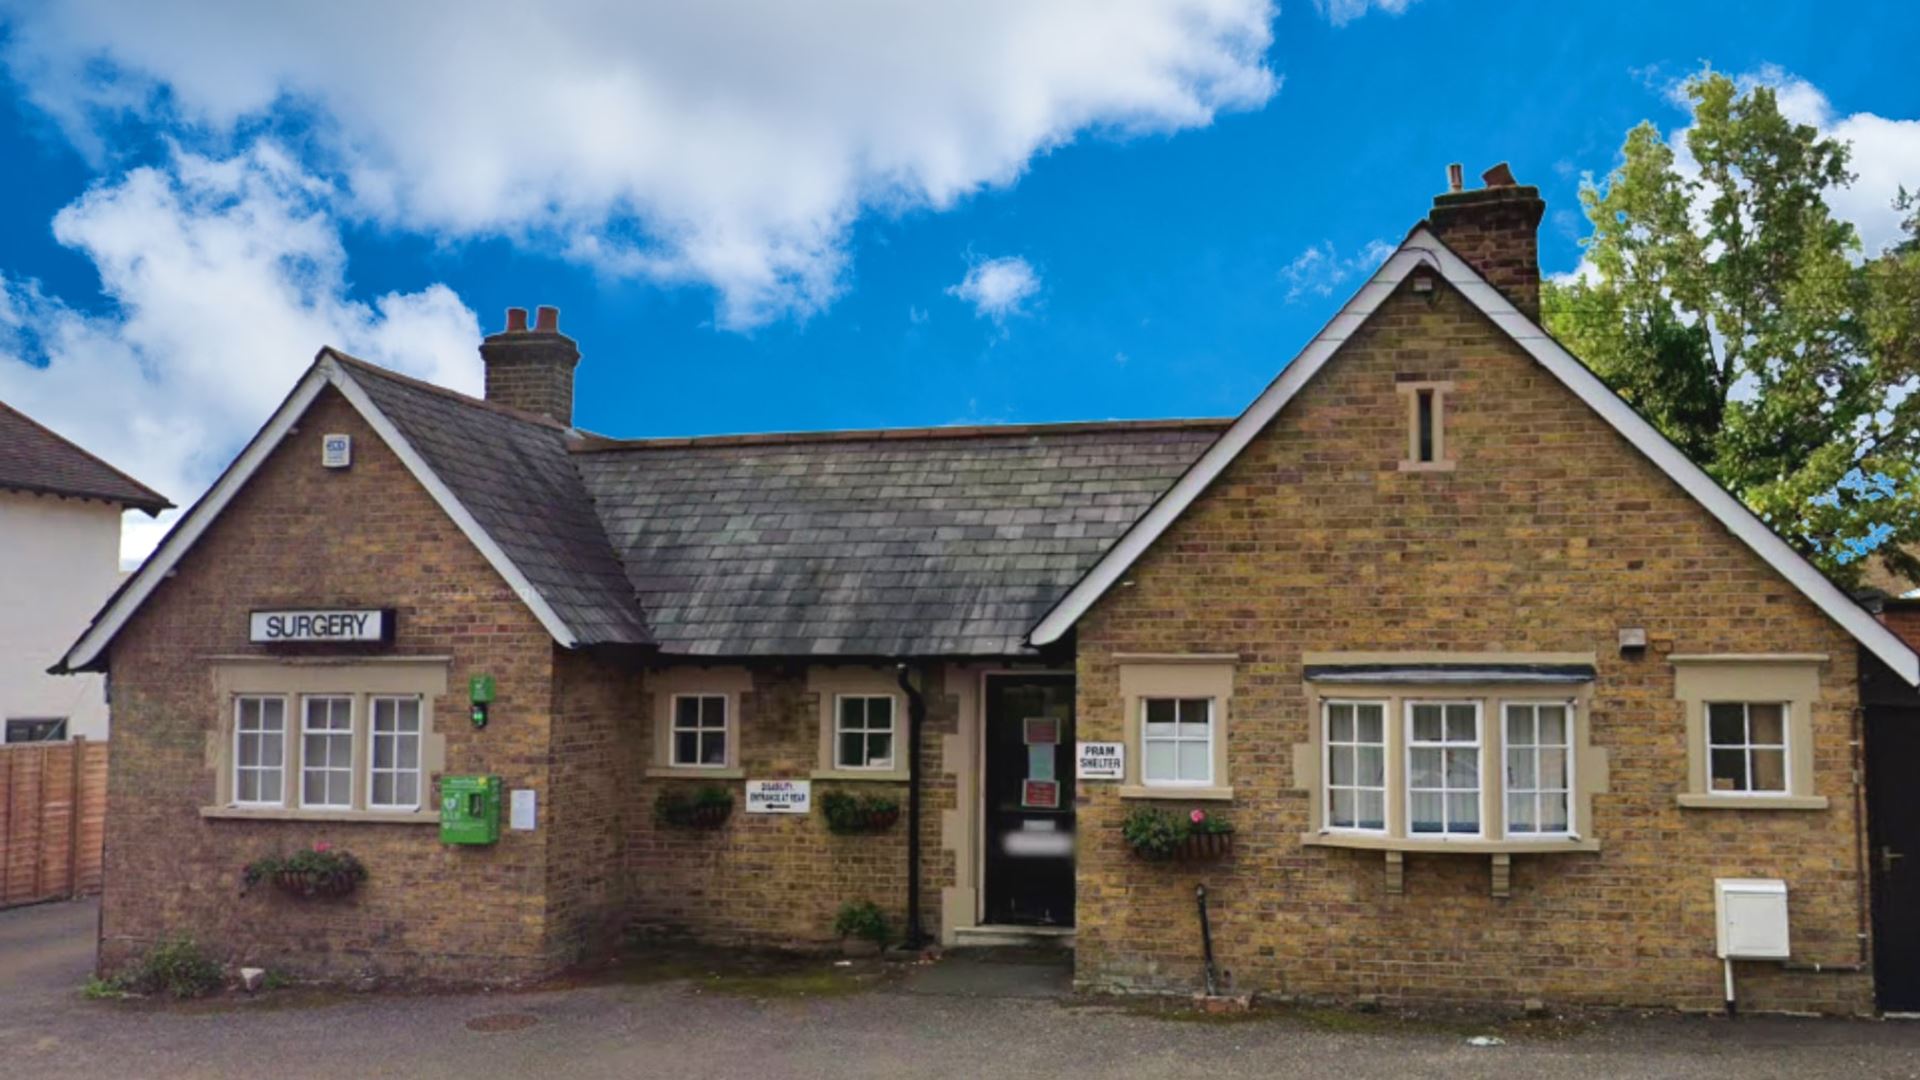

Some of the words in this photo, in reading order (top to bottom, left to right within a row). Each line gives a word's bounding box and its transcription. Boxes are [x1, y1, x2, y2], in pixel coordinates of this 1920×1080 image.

[266, 614, 369, 638] SURGERY
[1084, 745, 1115, 756] PRAM
[1080, 758, 1121, 769] SHELTER
